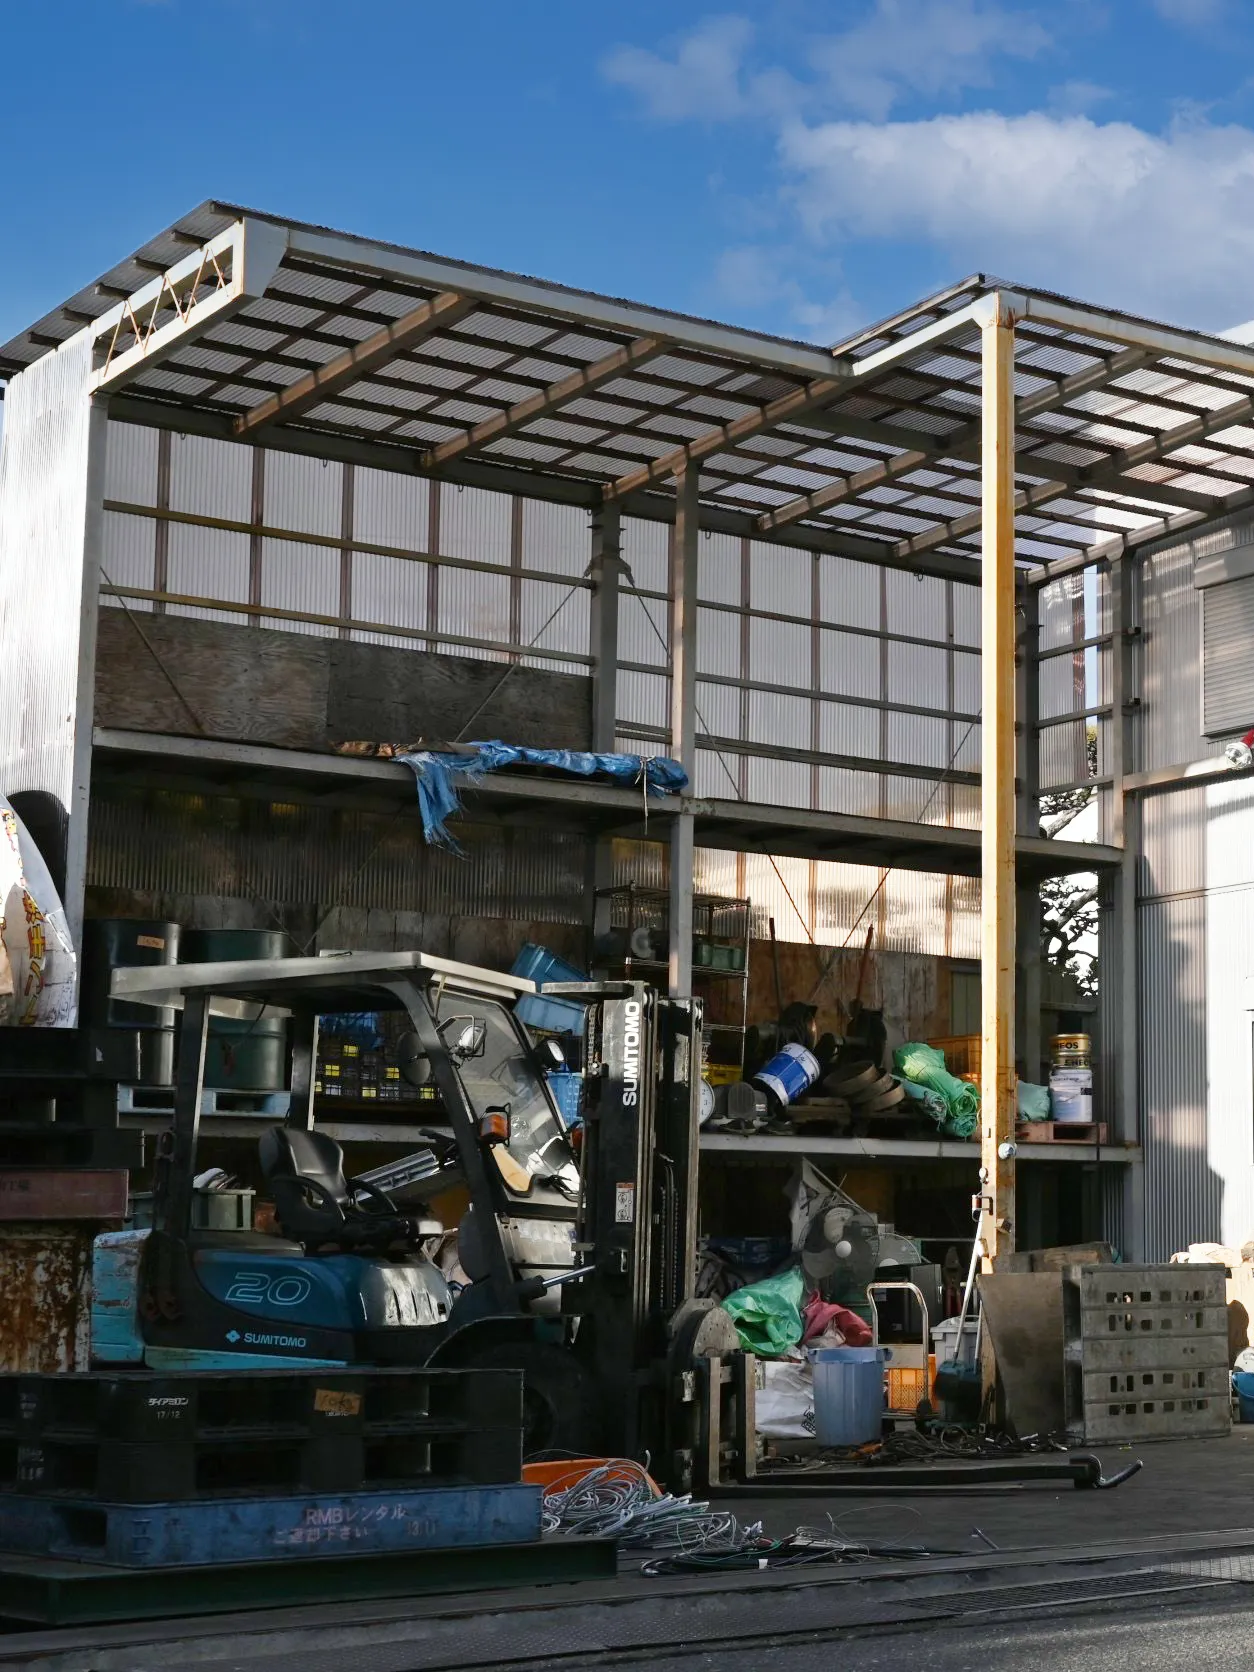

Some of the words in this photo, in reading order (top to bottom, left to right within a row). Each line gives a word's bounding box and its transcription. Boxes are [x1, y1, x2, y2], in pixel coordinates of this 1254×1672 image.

[622, 1002, 640, 1106] SUMITOMO
[225, 1271, 311, 1306] 20
[243, 1332, 307, 1348] SUMITOMO
